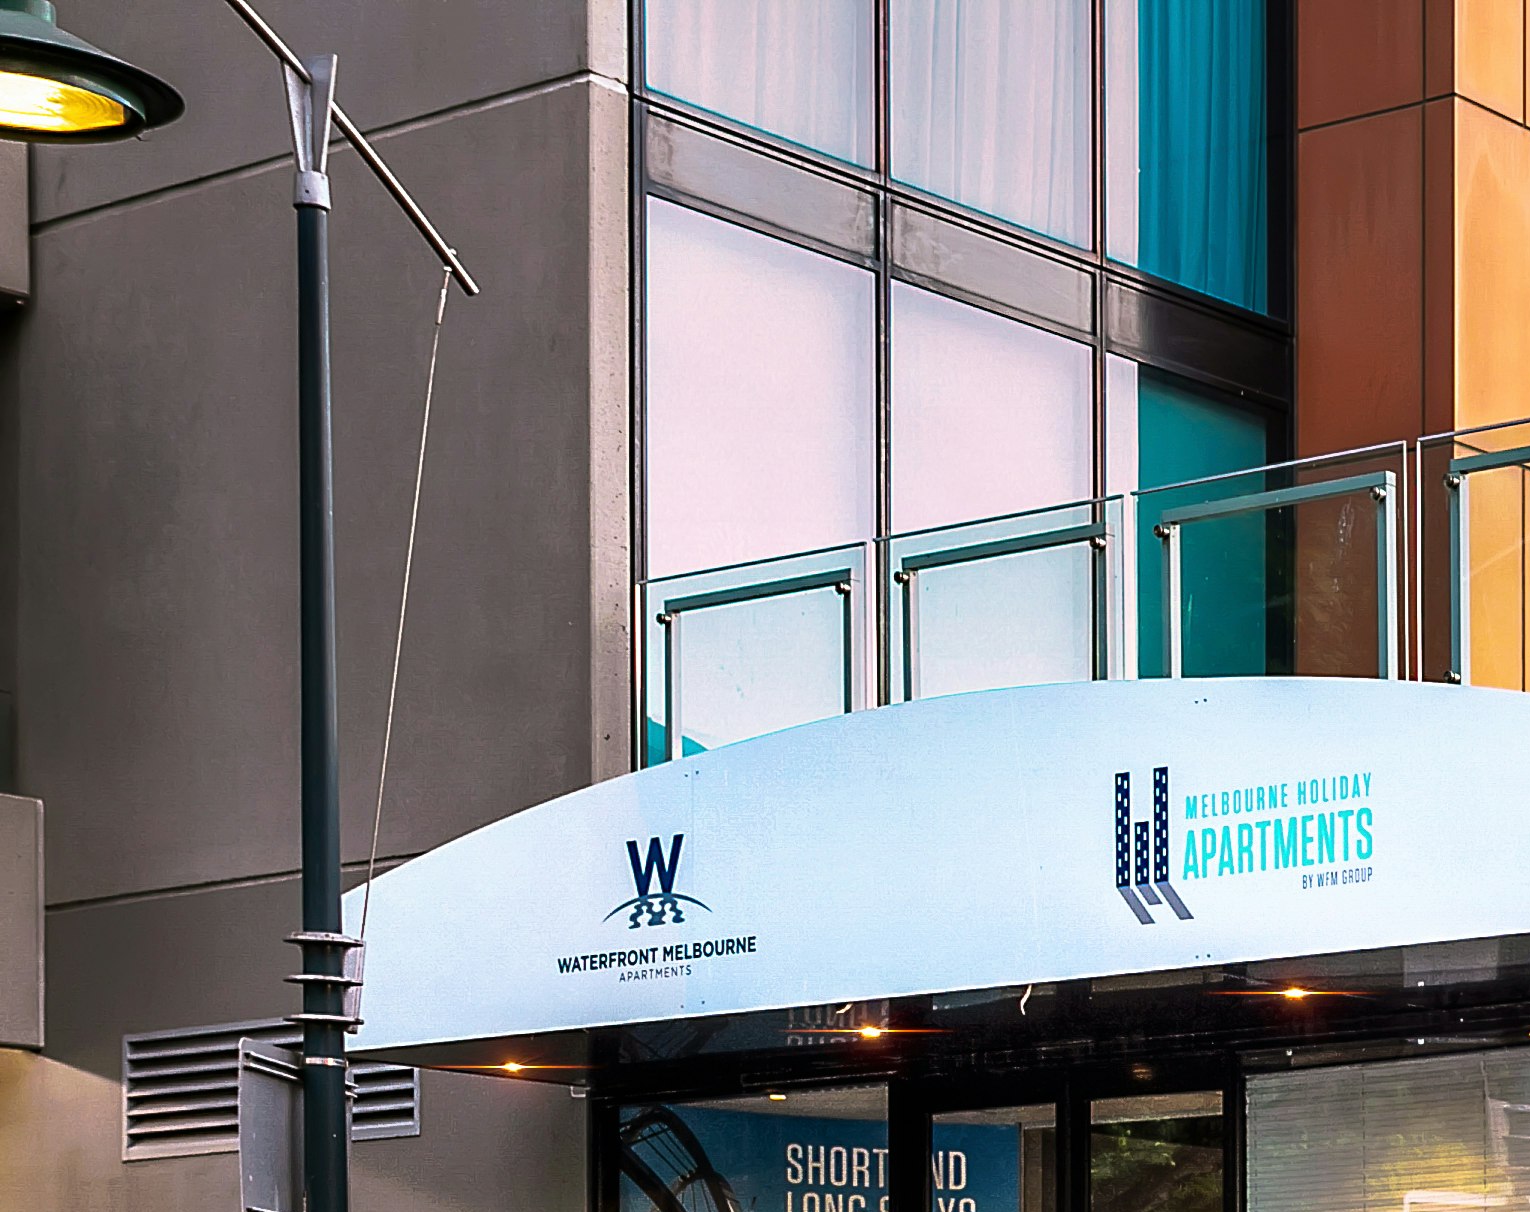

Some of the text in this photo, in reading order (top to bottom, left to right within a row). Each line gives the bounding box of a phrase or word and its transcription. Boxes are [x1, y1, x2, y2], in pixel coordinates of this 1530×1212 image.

[1186, 772, 1371, 819] MELBOURNE HOLIDAY
[626, 834, 684, 896] W
[1183, 807, 1373, 880] APARTMENTS
[1302, 867, 1373, 890] BY WFM GROUP
[557, 936, 757, 974] WATERFRONT MELBOURNE
[619, 965, 692, 983] APARTMENTS
[787, 1143, 967, 1190] SHORT ND
